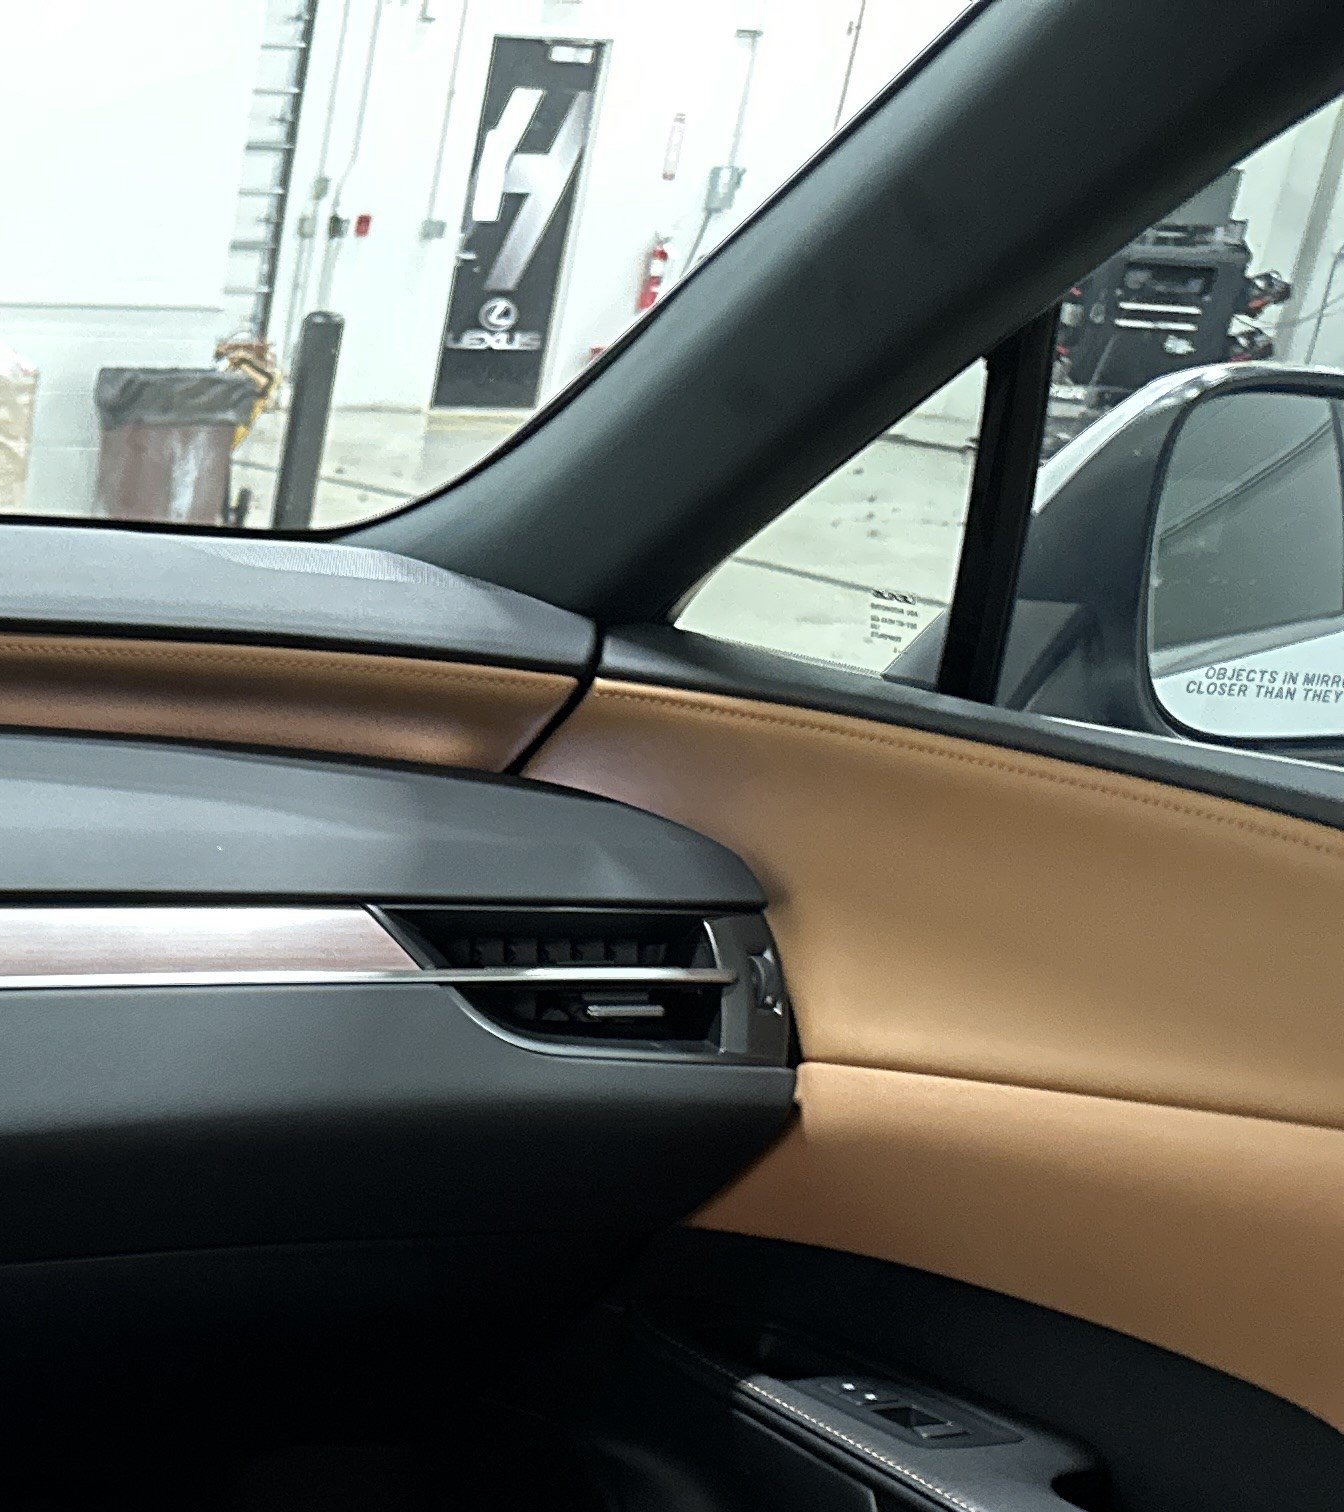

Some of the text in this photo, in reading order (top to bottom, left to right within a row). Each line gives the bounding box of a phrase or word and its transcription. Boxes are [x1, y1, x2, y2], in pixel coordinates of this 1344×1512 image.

[446, 328, 542, 351] LEXUS
[1204, 666, 1279, 684] OBJECTS
[1282, 670, 1300, 685] IN
[1185, 680, 1344, 704] CLOSER THAN THEY
